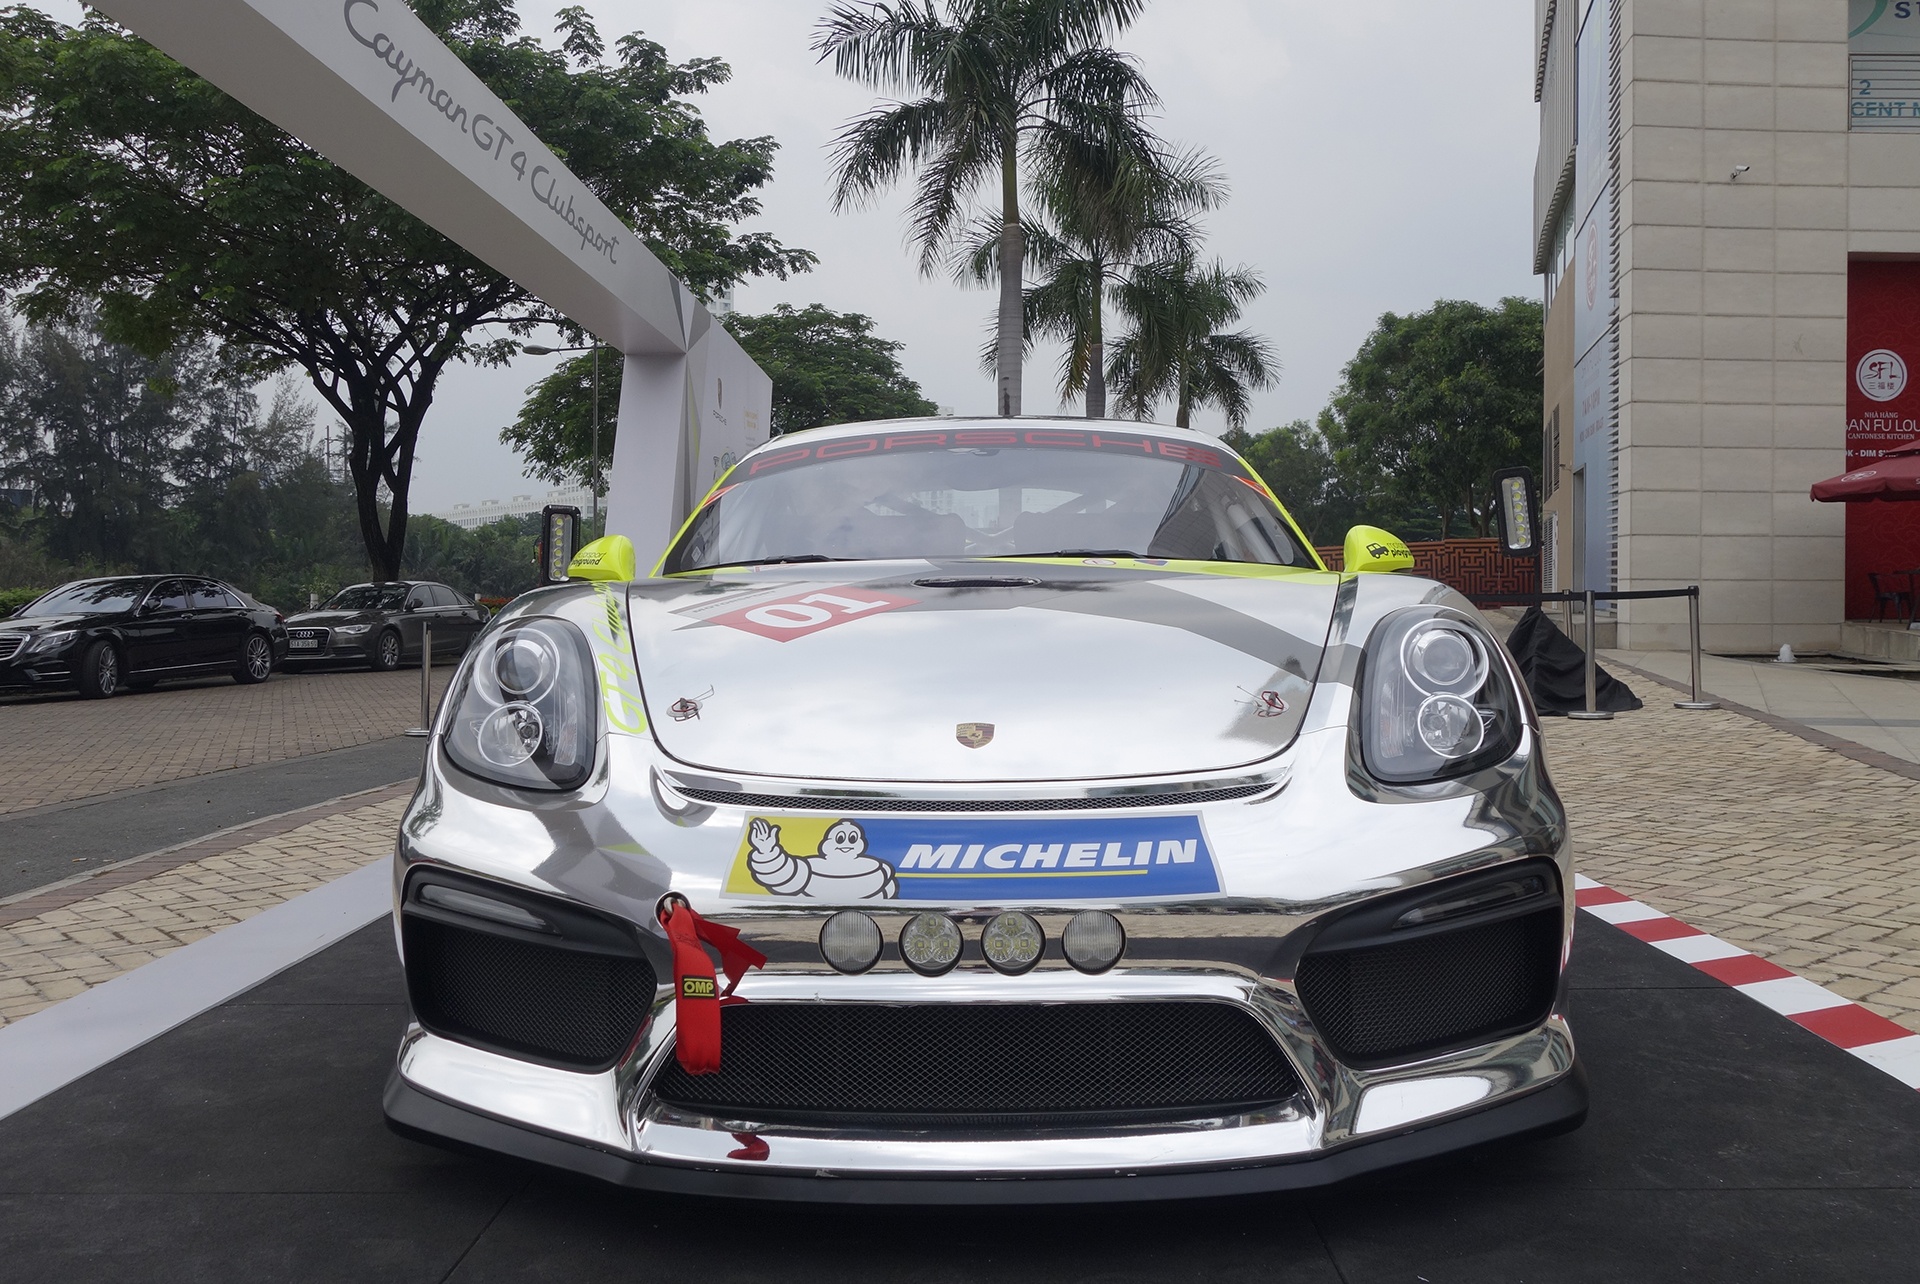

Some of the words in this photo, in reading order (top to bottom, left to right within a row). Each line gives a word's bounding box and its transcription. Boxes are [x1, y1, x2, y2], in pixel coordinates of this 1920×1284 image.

[1859, 80, 1871, 95] 2
[343, 0, 468, 134] Cayman
[530, 165, 620, 265] Clubsport
[1862, 361, 1901, 379] SFL
[1845, 419, 1870, 431] AN
[1873, 419, 1892, 432] FU
[748, 431, 1222, 475] PORSCHE
[745, 593, 890, 628] 01
[900, 839, 1197, 868] MICHELIN
[683, 981, 714, 993] OMP
